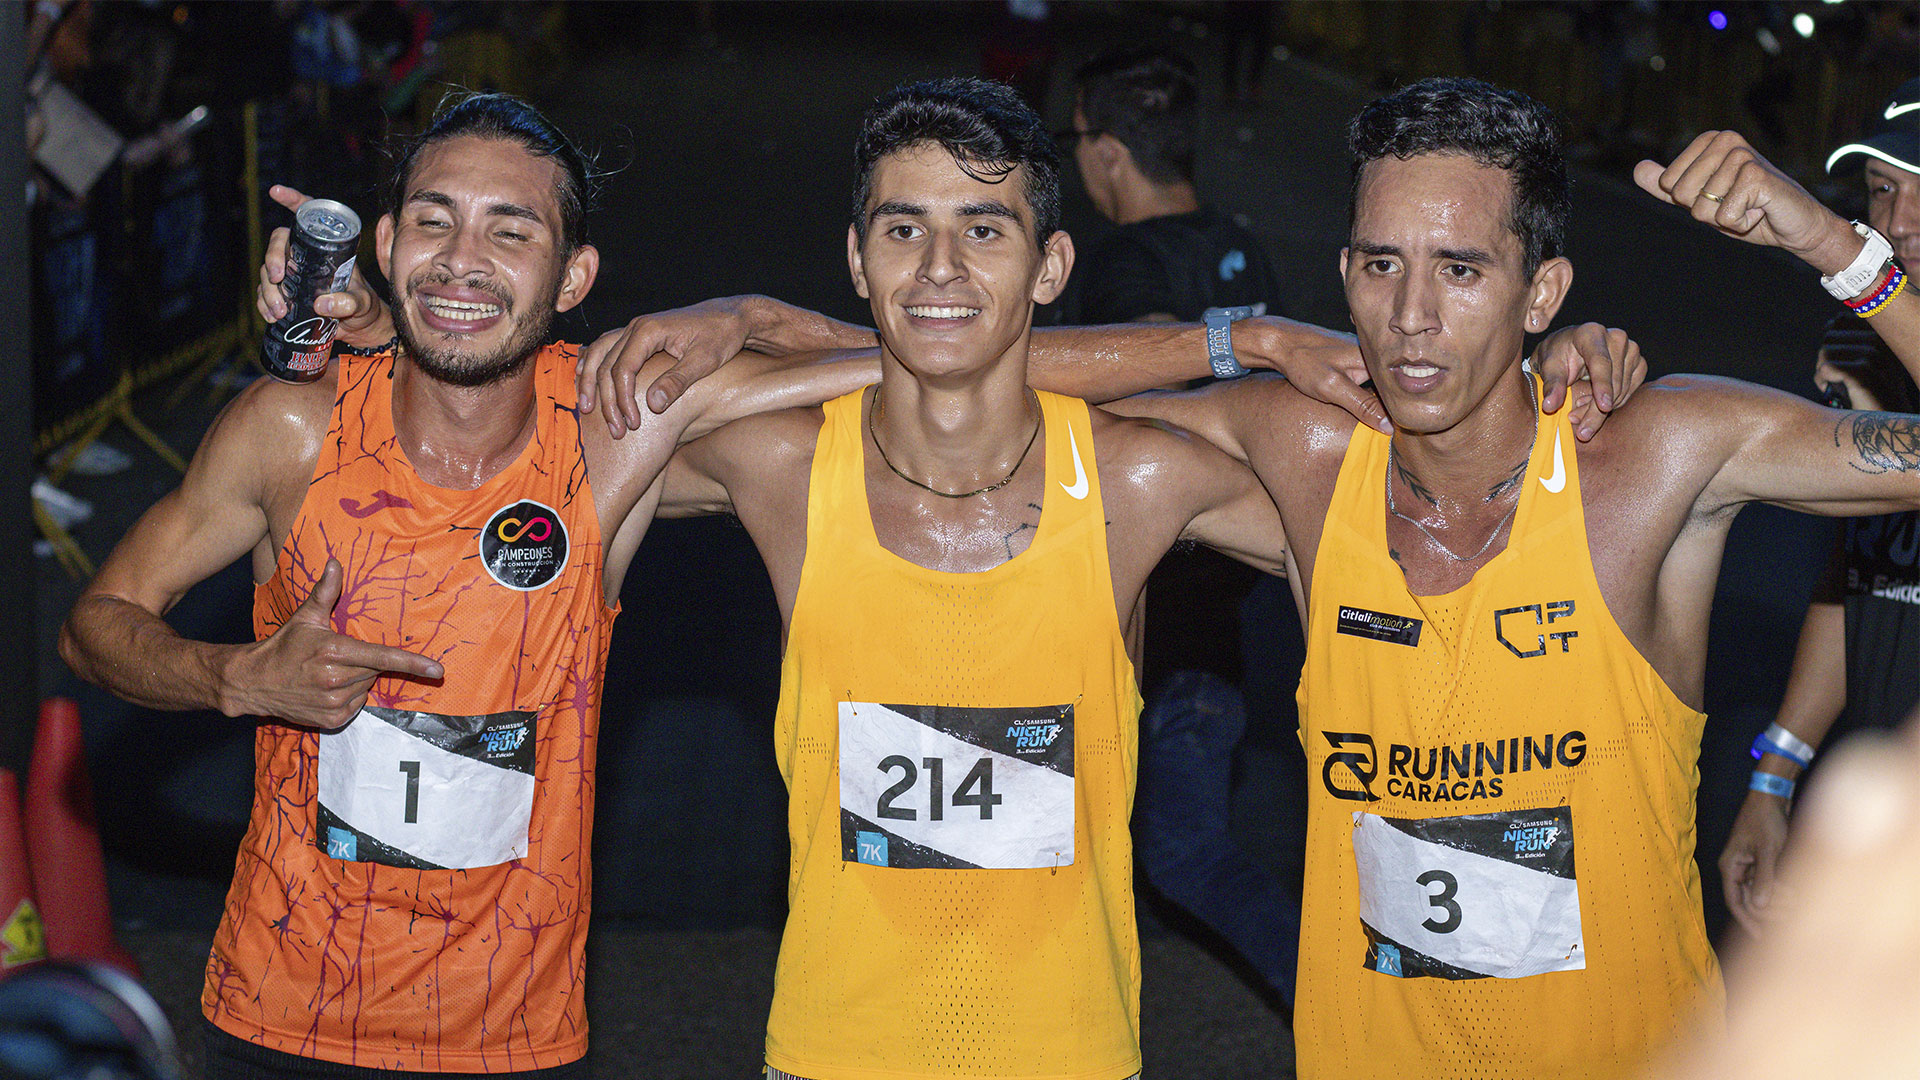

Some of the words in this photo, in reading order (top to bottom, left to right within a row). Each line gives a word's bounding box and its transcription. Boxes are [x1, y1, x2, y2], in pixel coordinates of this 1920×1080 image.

[498, 546, 553, 560] CAMPEONES
[487, 740, 519, 752] RUN
[1016, 736, 1051, 747] RUN
[1388, 730, 1587, 781] RUNNING
[399, 761, 421, 824] 1
[876, 754, 1003, 821] 214
[1386, 777, 1504, 802] CARACAS
[331, 838, 351, 858] 7K
[860, 843, 882, 861] 7K
[1514, 838, 1550, 852] RUN
[1415, 869, 1463, 934] 3
[1380, 951, 1400, 972] 7K
